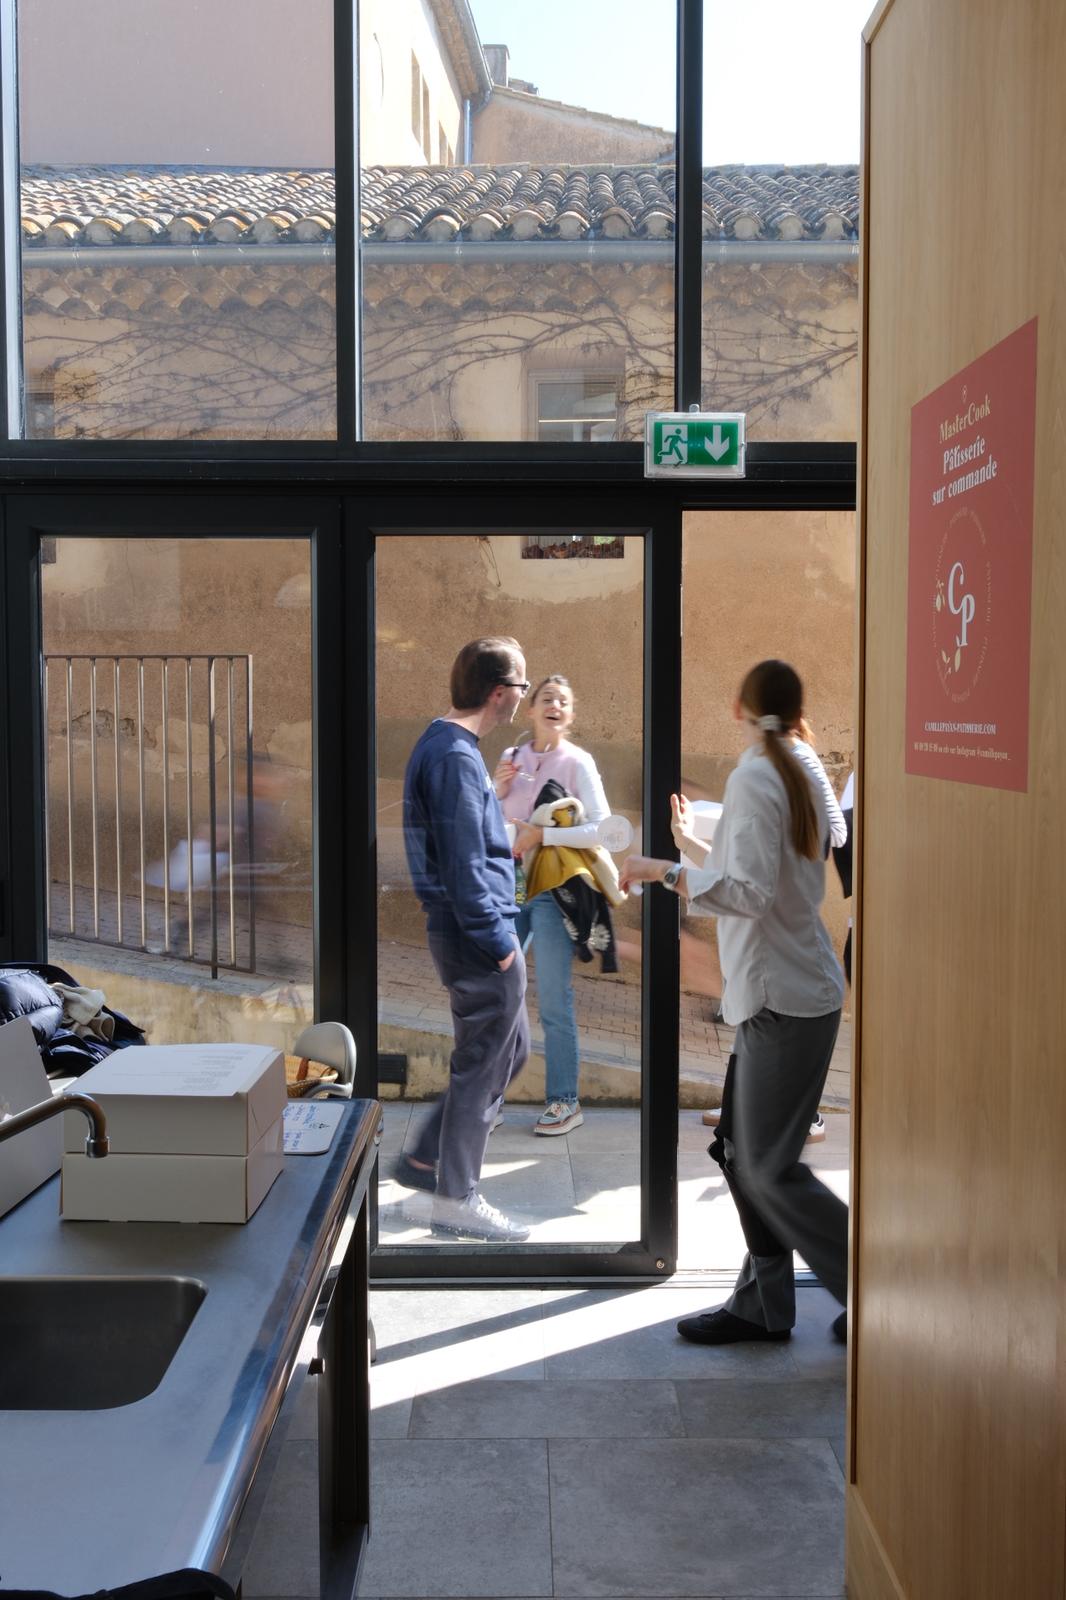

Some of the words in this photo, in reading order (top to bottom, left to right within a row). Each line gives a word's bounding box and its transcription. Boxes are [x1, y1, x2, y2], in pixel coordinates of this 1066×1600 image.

[939, 393, 991, 444] MasterCook
[932, 486, 946, 506] sur
[948, 454, 998, 498] commande
[943, 435, 985, 475] Pâtisserie
